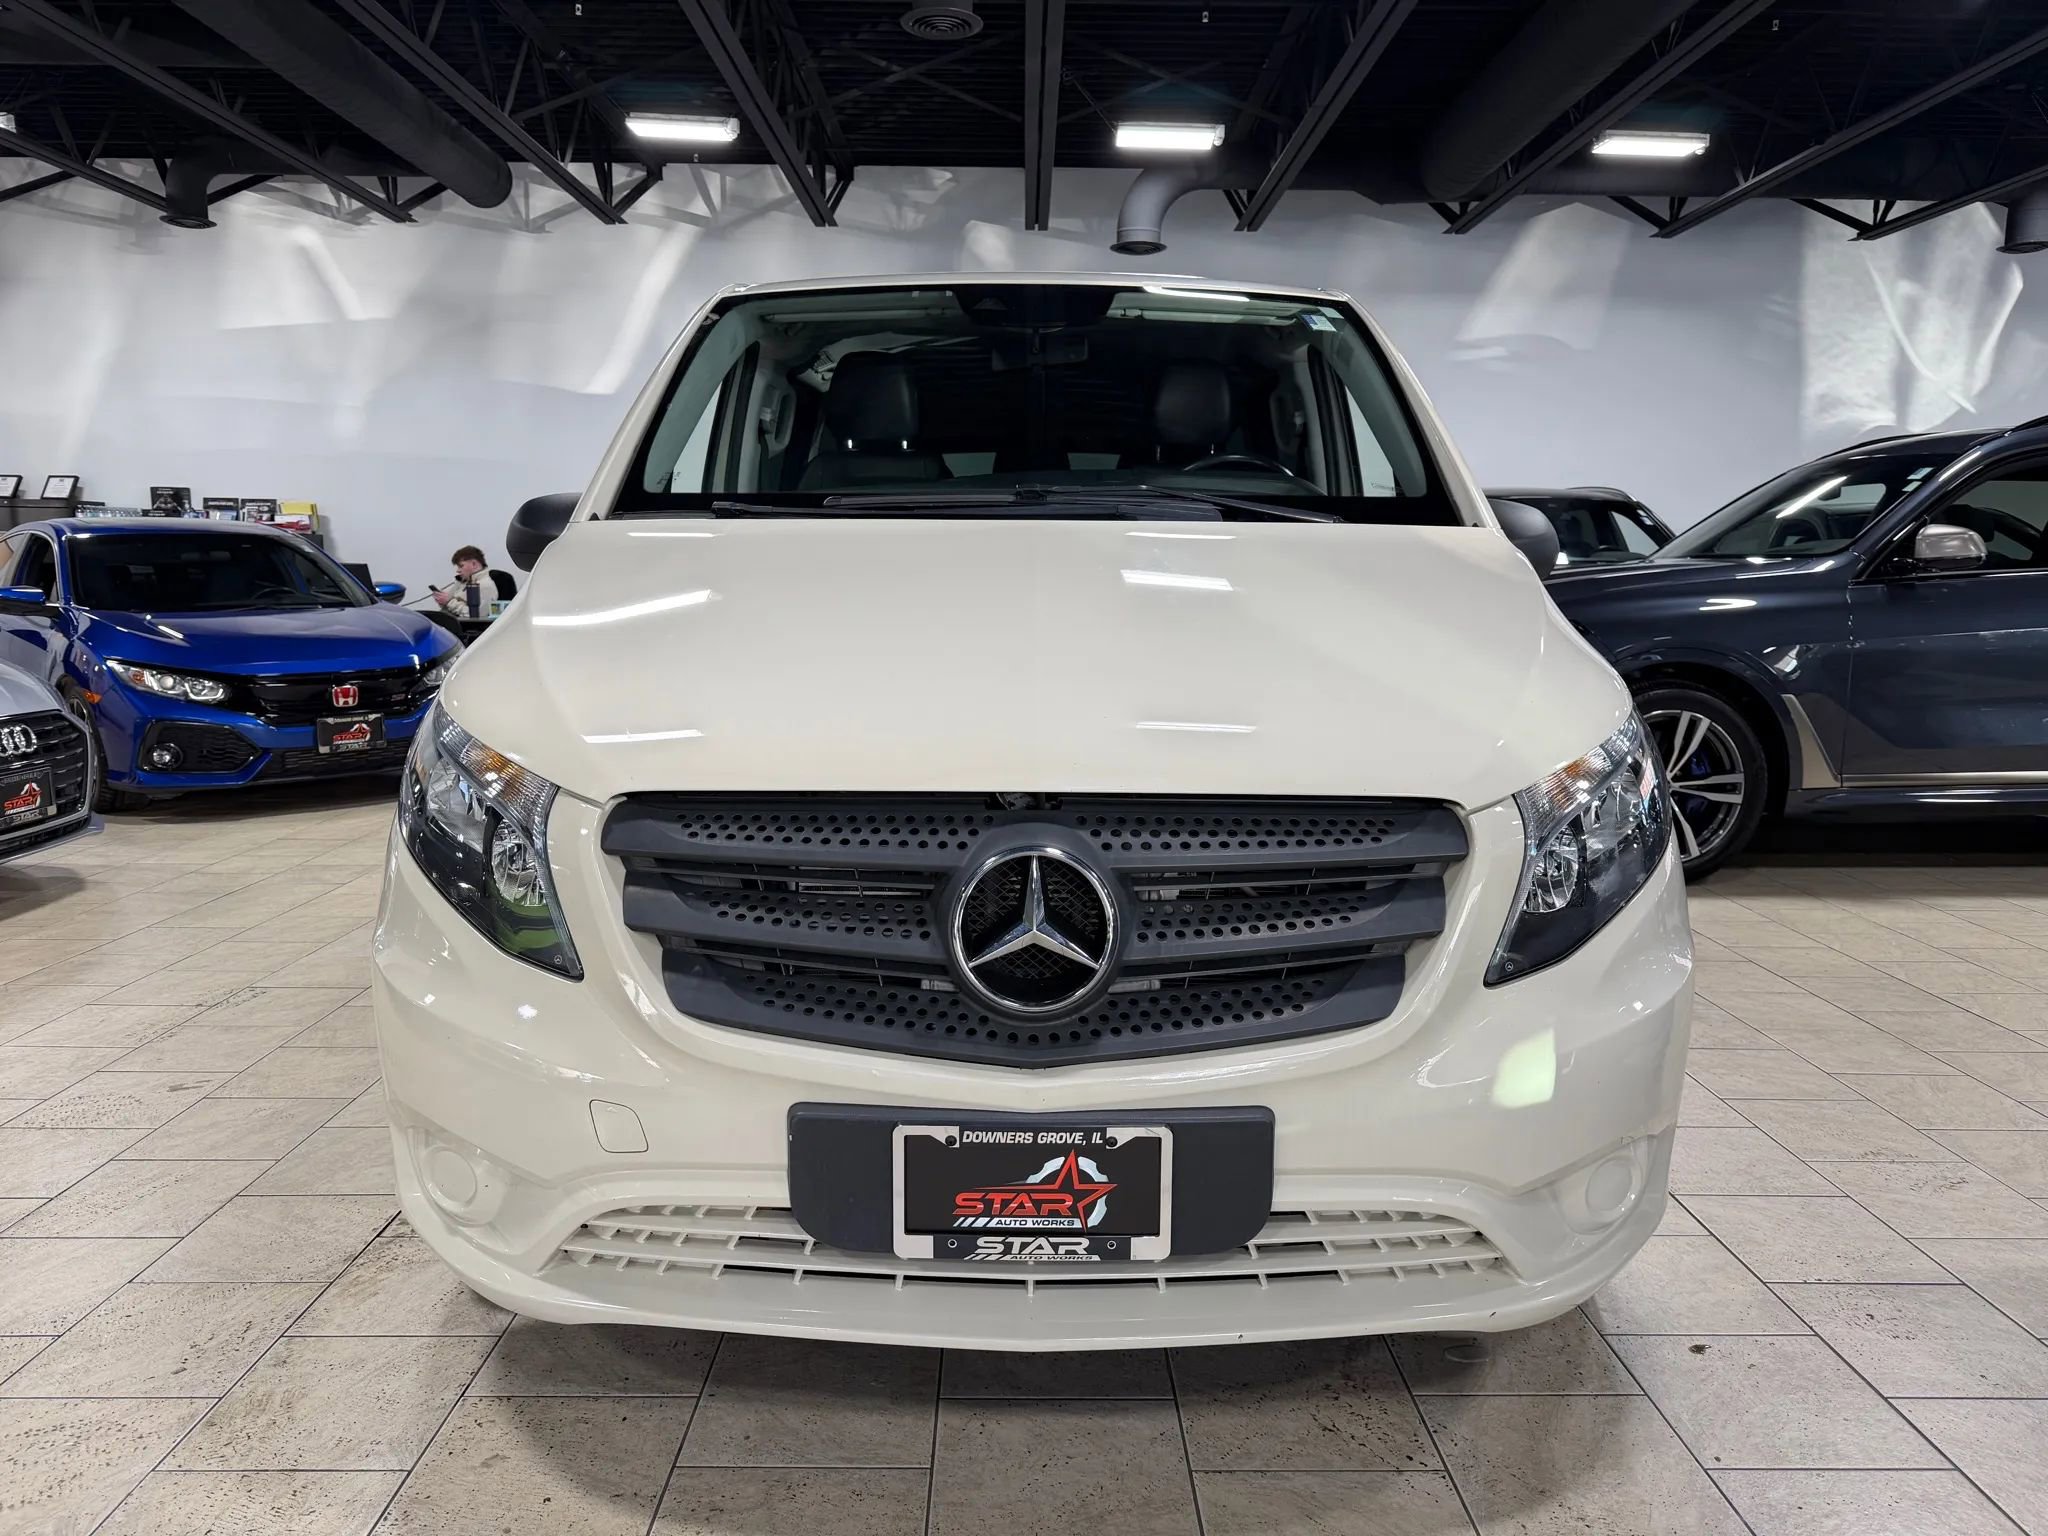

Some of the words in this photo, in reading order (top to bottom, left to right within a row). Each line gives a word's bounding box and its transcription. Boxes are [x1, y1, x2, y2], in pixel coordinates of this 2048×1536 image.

[4, 796, 33, 810] STAR
[962, 1130, 1034, 1144] DOWNERS
[1037, 1132, 1087, 1145] GROVE,
[1091, 1132, 1104, 1144] IL
[952, 1192, 1074, 1216] STAR
[995, 1219, 1028, 1227] AUTO
[1031, 1219, 1075, 1227] WORKS
[974, 1236, 1090, 1255] STAR
